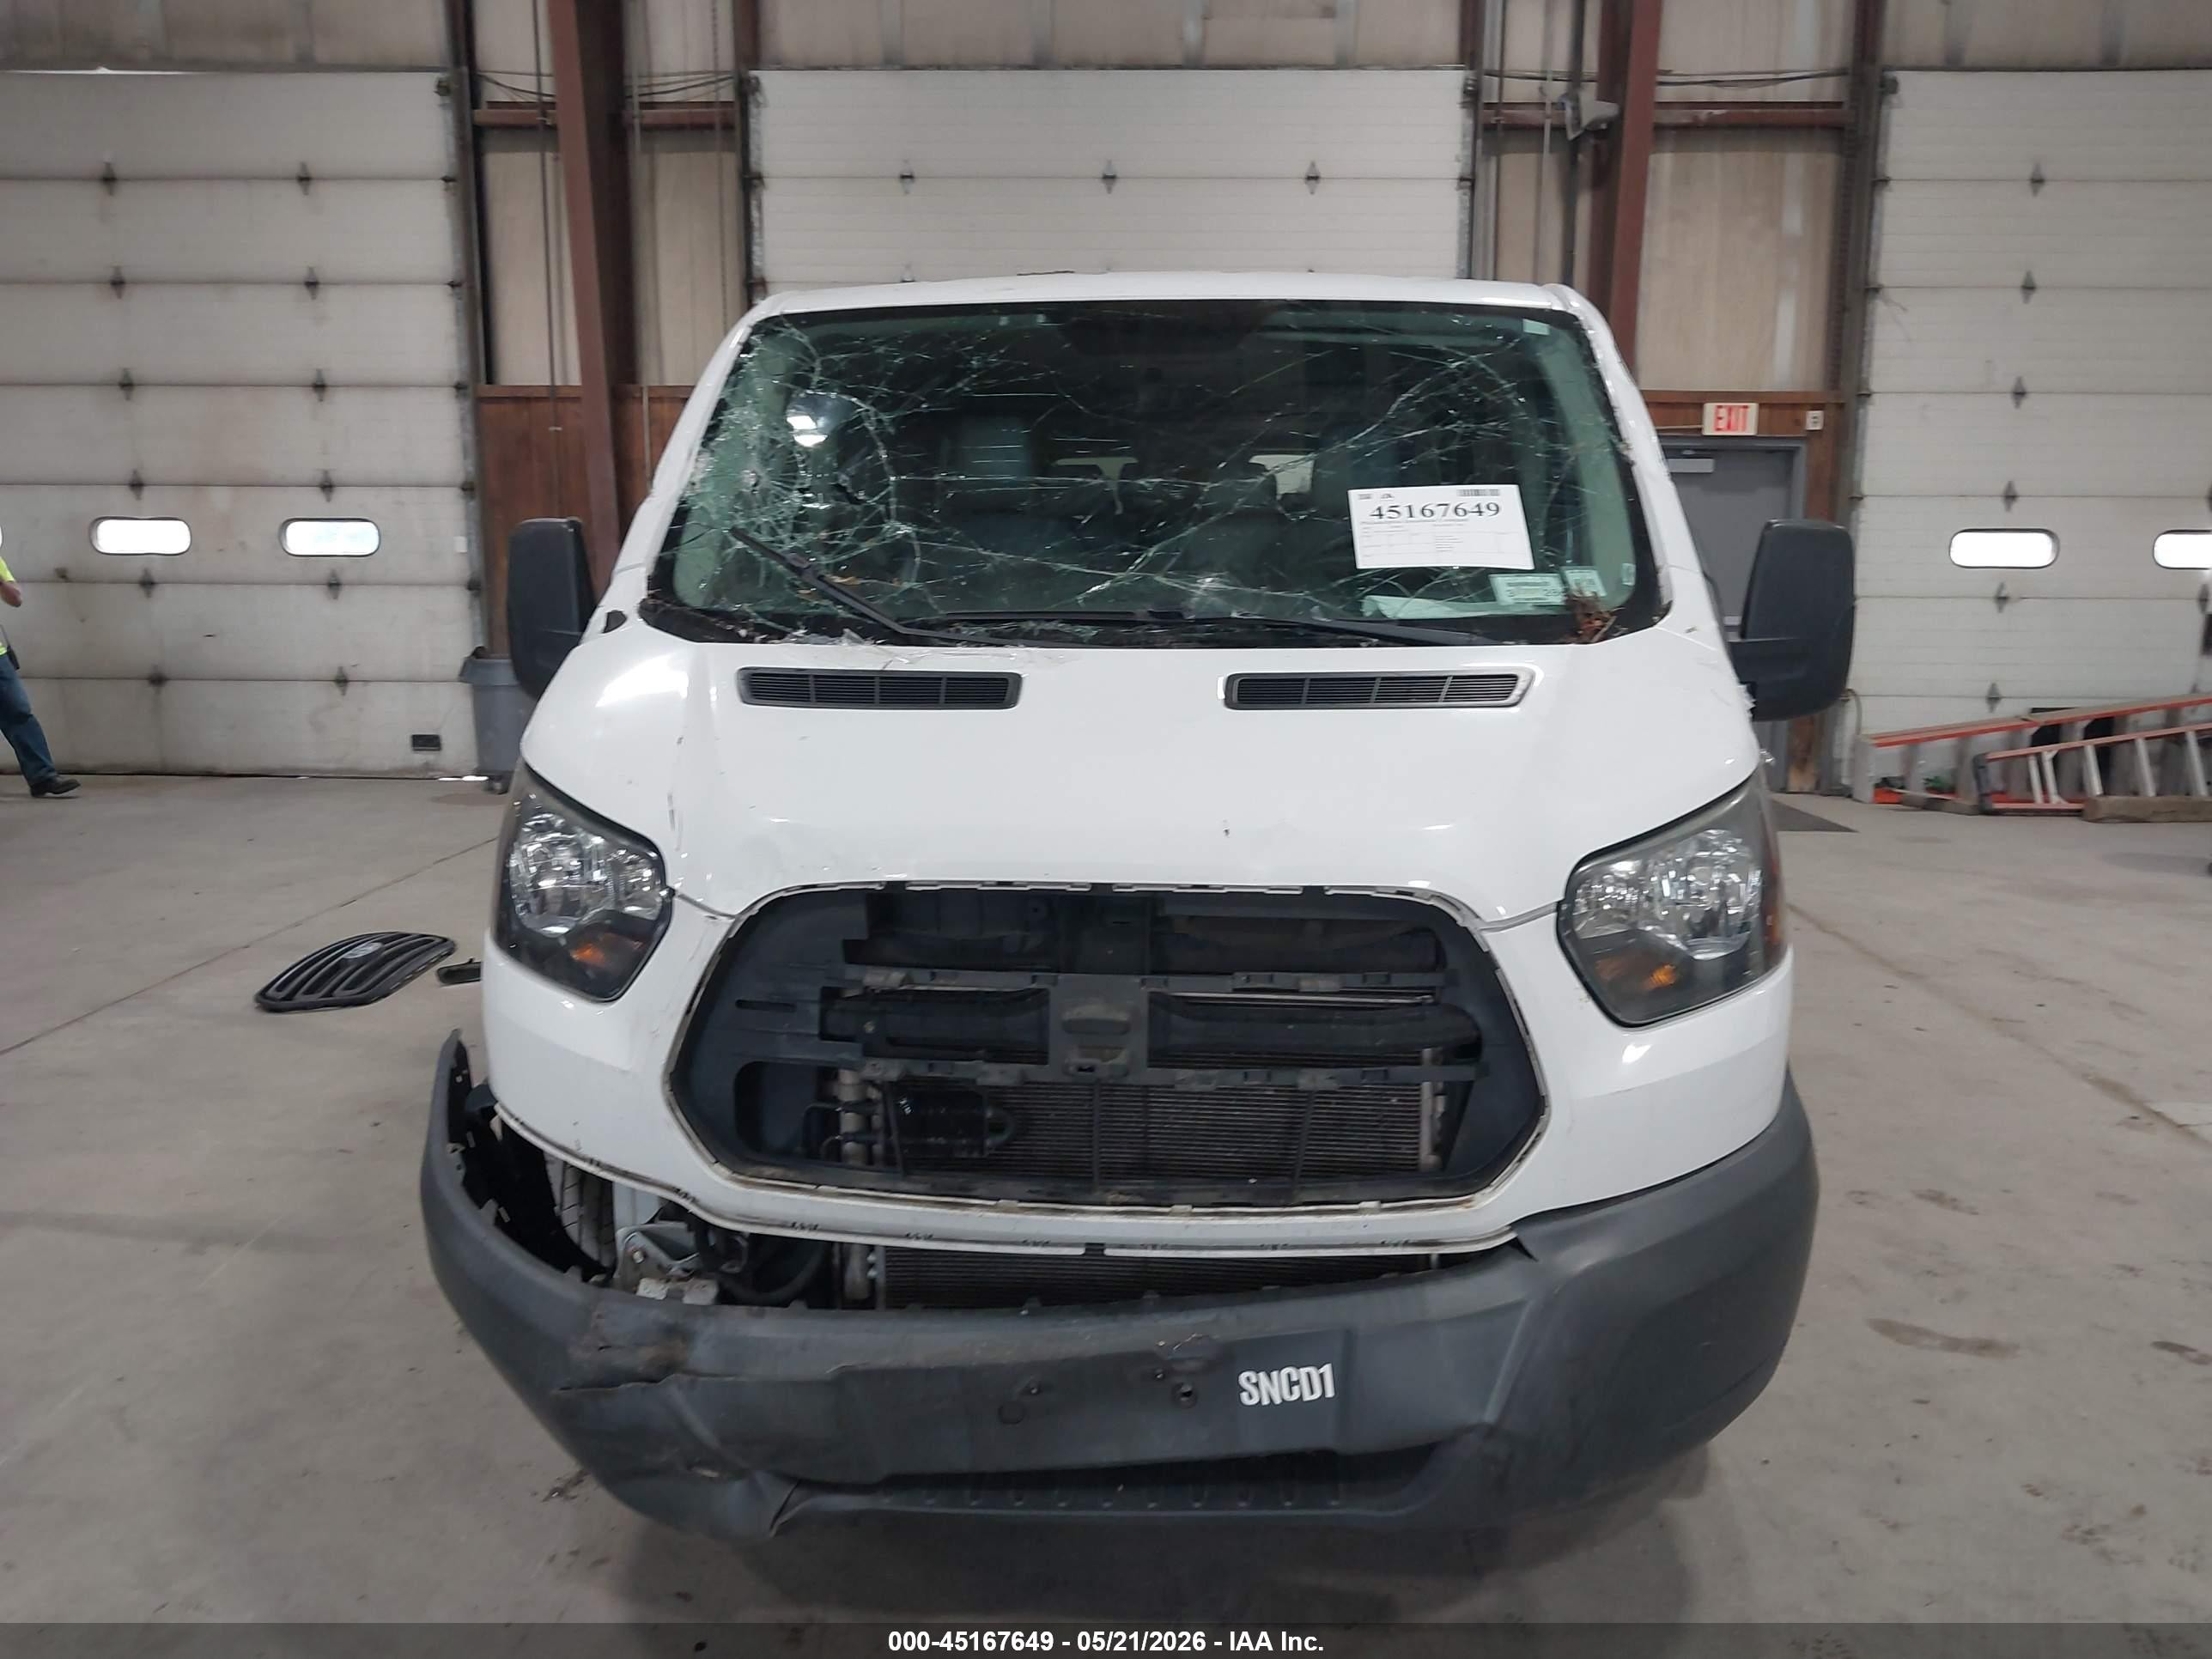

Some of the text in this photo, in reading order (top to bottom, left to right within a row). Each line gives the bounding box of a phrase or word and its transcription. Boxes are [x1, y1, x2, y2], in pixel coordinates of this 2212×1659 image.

[1713, 404, 1748, 431] EXIT
[1370, 501, 1500, 520] 45167649
[1238, 1363, 1335, 1406] SNCD1
